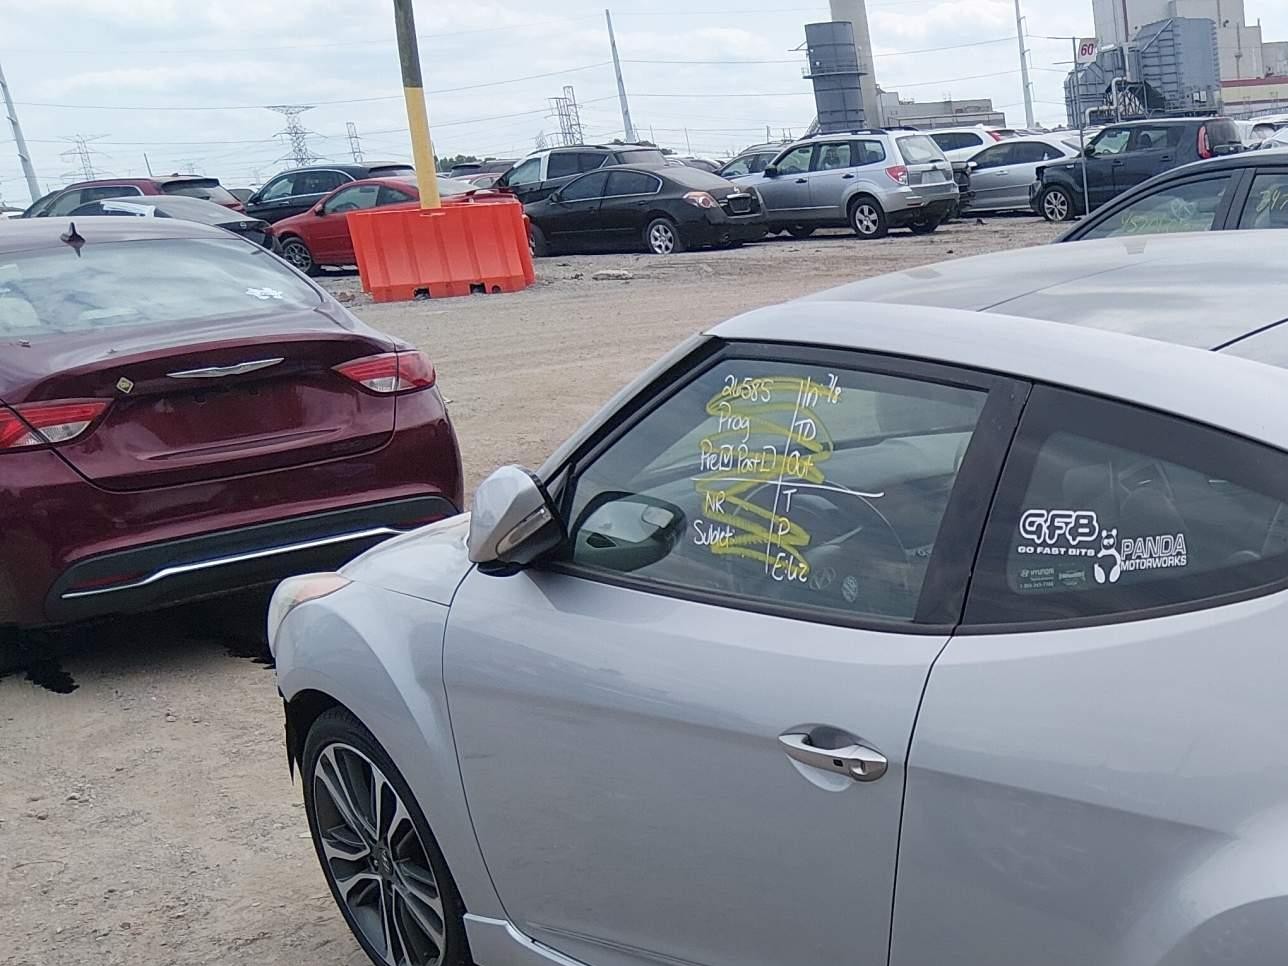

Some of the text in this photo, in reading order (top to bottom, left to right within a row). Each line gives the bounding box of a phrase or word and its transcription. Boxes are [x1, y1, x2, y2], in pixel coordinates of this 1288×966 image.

[1081, 43, 1094, 56] 60
[721, 374, 774, 402] 26585
[718, 401, 751, 443] Prog
[700, 439, 720, 471] Pre
[782, 488, 798, 513] T
[1019, 509, 1099, 546] GFB
[1017, 545, 1035, 554] GO
[1036, 546, 1067, 555] FAST
[1120, 533, 1187, 561] PANDA
[1120, 555, 1188, 572] MOTORWORKS
